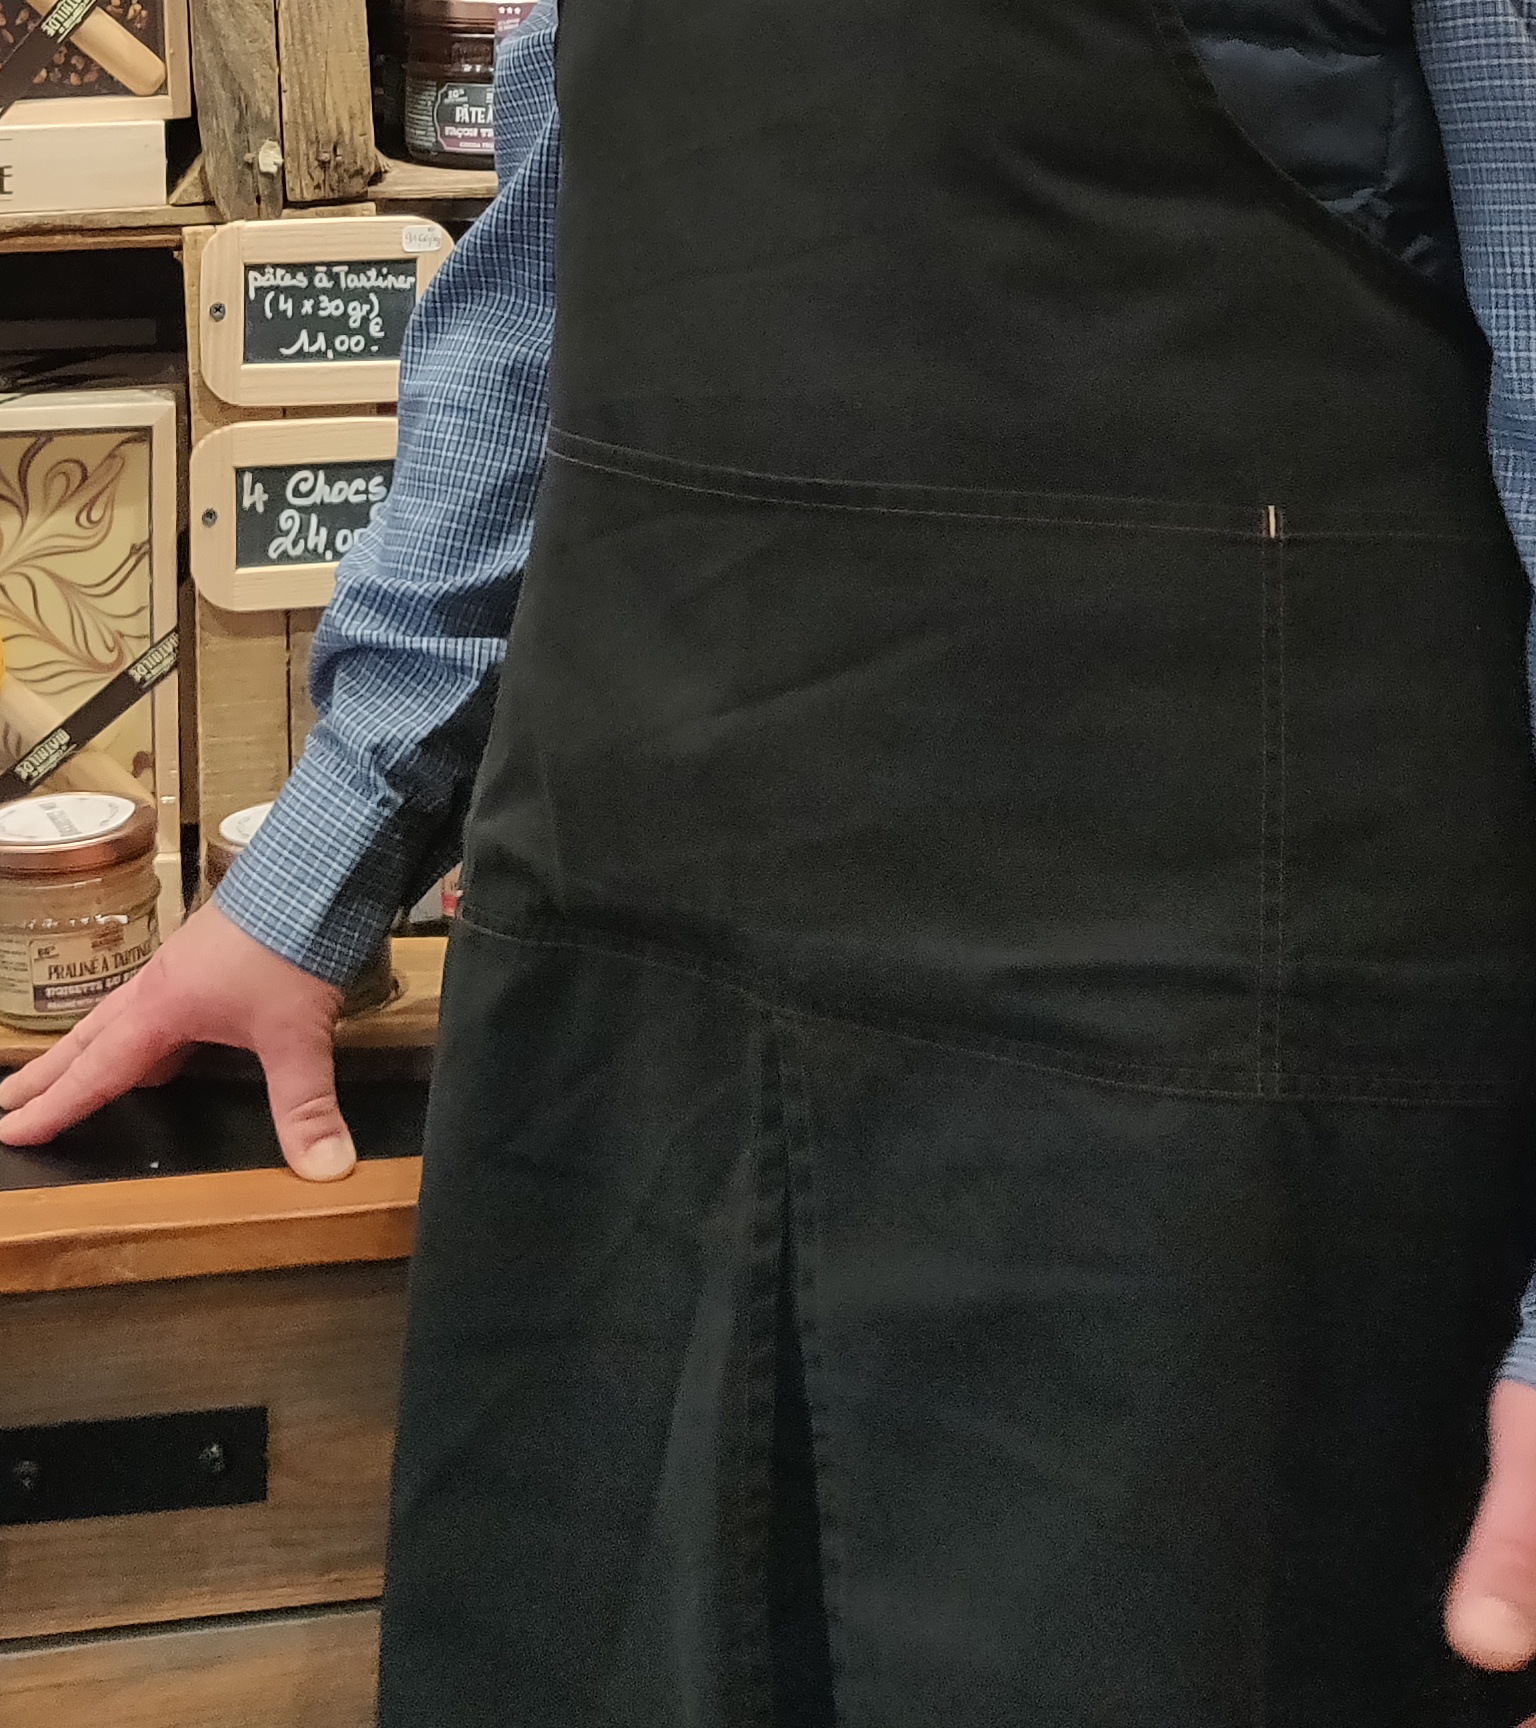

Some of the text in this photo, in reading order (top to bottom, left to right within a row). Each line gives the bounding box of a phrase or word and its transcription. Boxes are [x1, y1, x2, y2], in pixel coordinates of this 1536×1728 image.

[332, 265, 415, 289] Tartiner
[318, 296, 344, 317] 30
[242, 470, 387, 513] 4 Chocs
